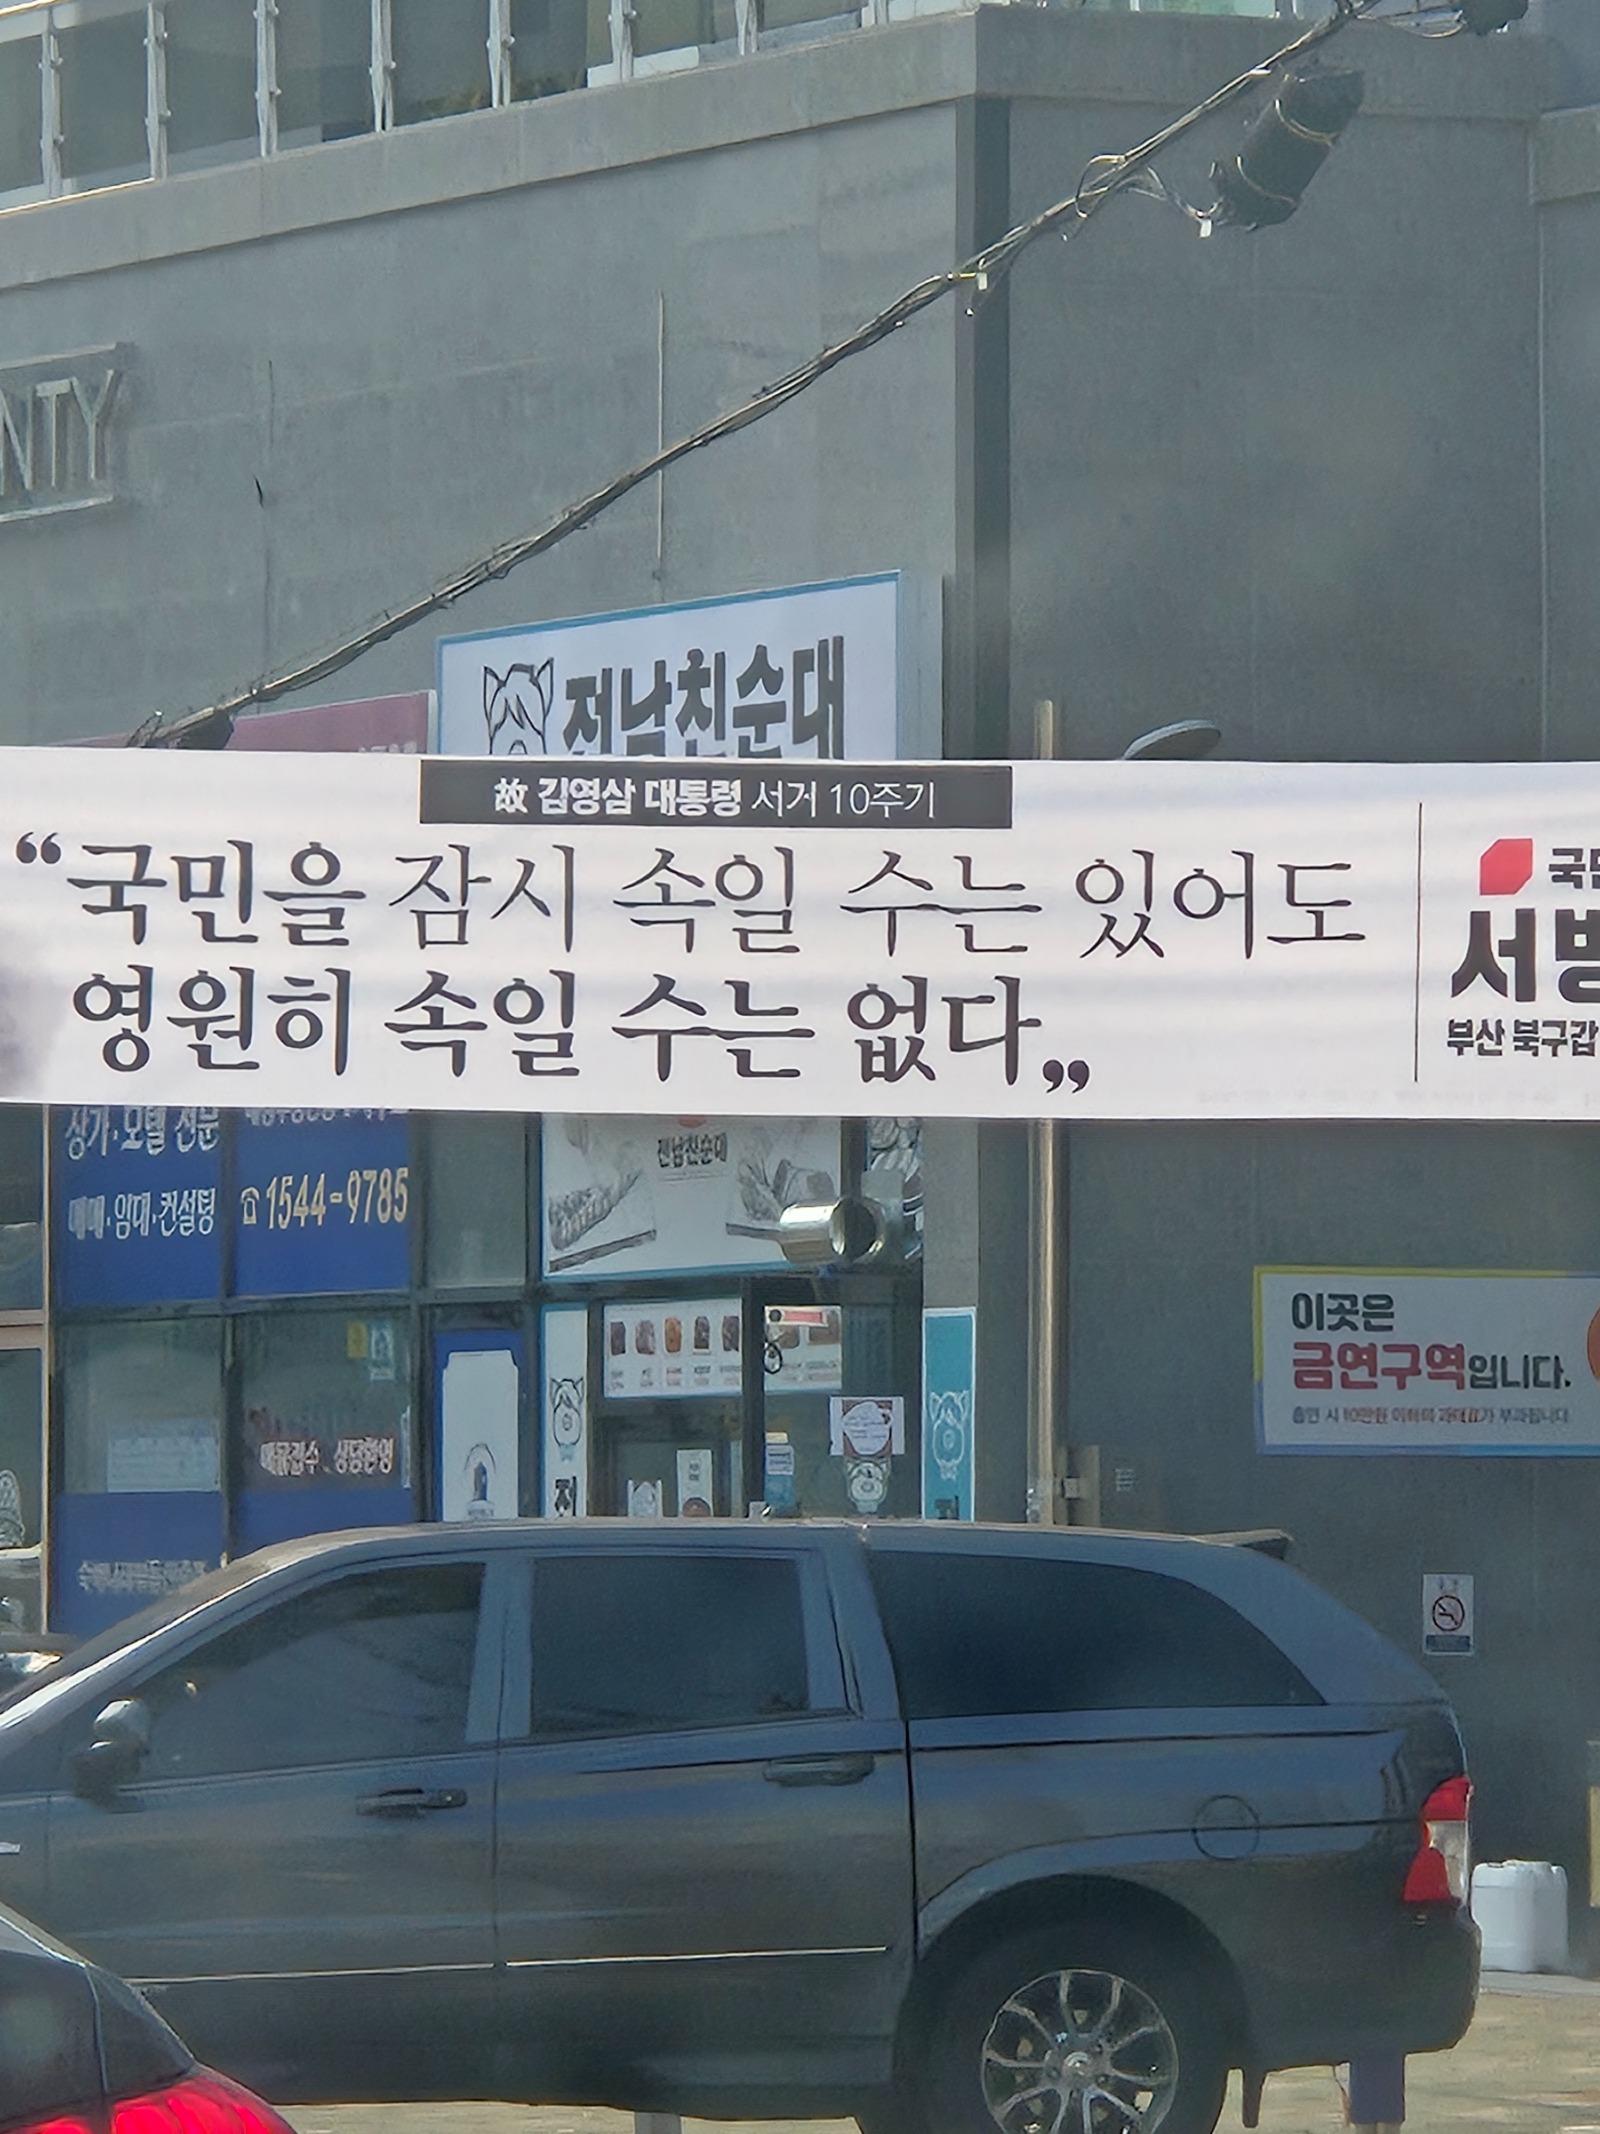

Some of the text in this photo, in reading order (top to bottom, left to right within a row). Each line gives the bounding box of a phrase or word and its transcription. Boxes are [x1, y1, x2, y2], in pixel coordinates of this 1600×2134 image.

[494, 777, 936, 819] 故 김영삼 대통령 서거 10주기
[389, 843, 575, 953] 잠시
[613, 846, 800, 954] 속일
[839, 850, 1043, 958] 수는
[1075, 849, 1366, 960] 있어도
[73, 964, 352, 1077] 영원히
[383, 969, 581, 1078] 속일
[611, 973, 816, 1083] 수는
[1447, 1018, 1600, 1058] 부산 북구갑
[265, 1166, 409, 1230] 1544-9785
[1291, 1292, 1395, 1333] 이곳은
[1292, 1341, 1572, 1391] 금연구역입니다.
